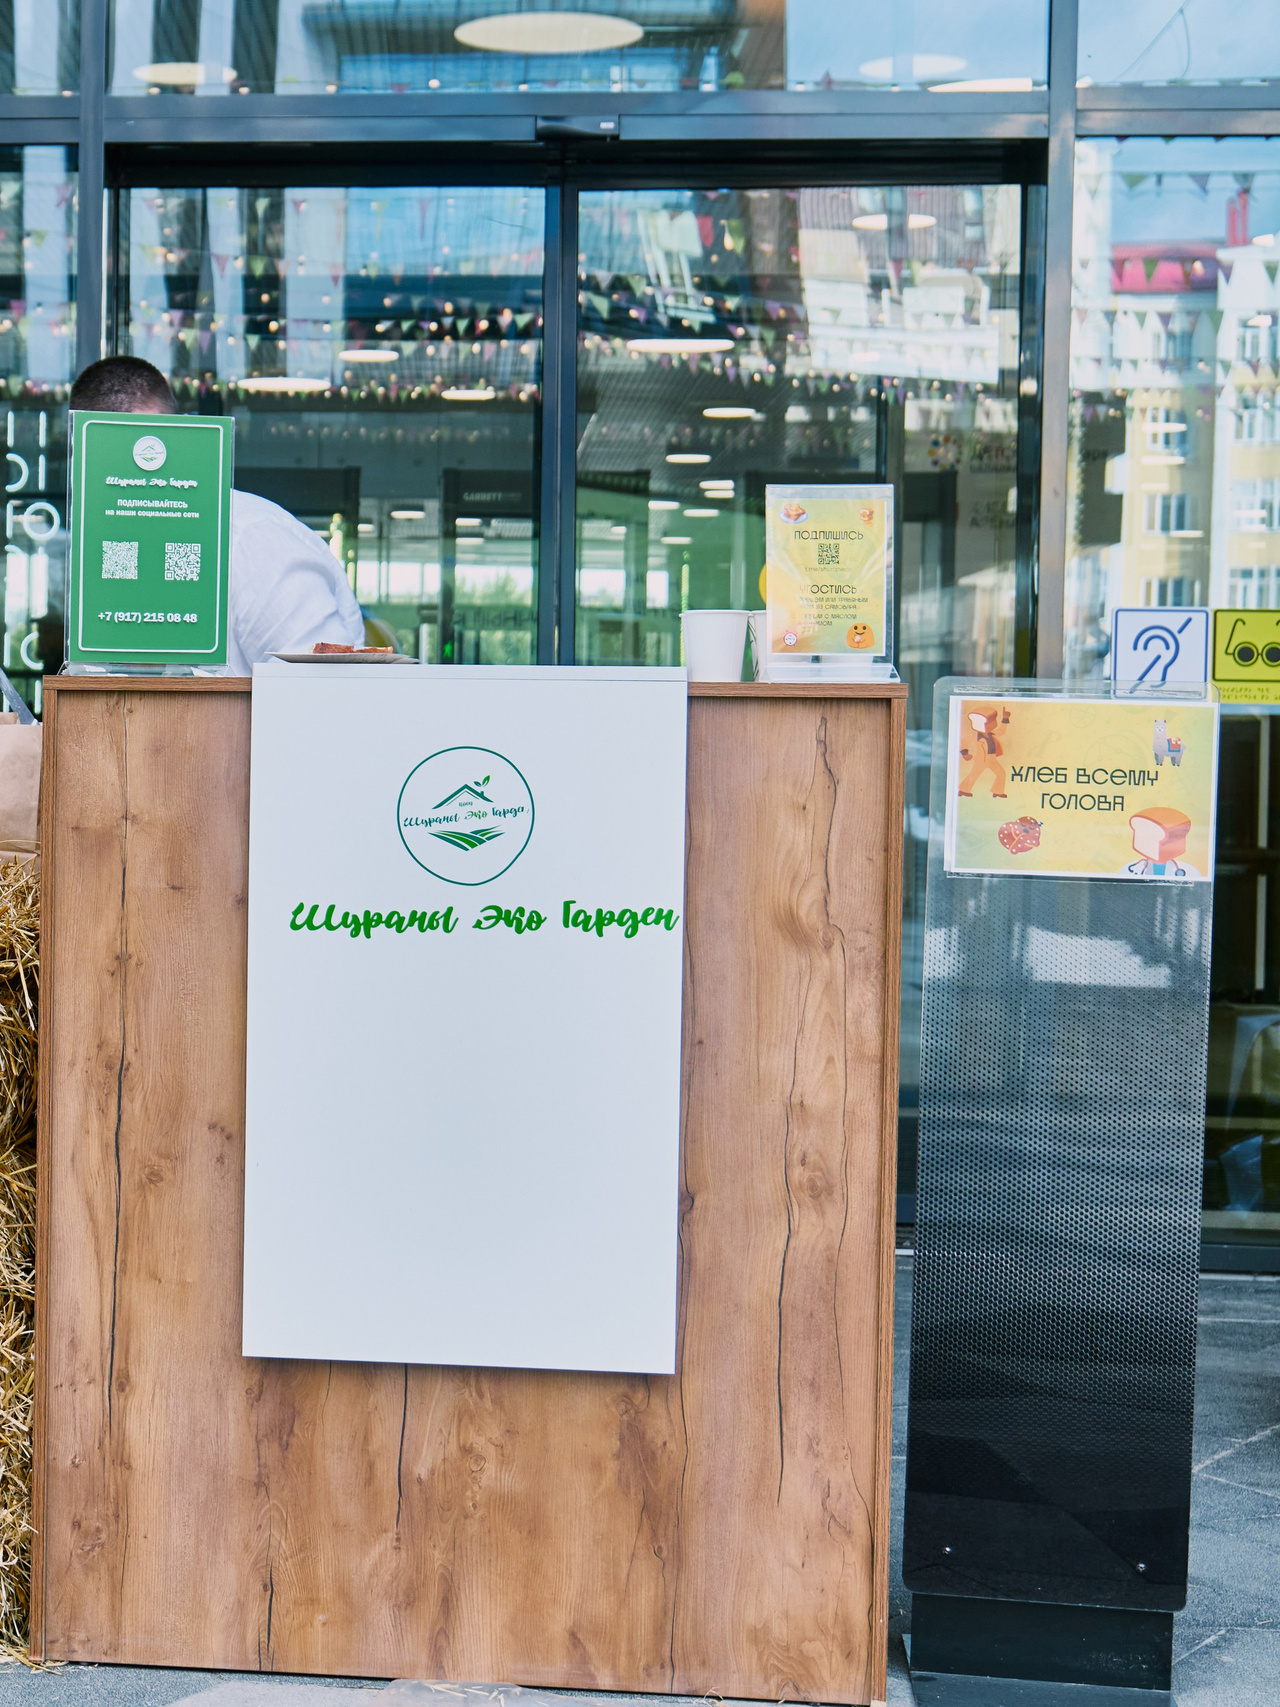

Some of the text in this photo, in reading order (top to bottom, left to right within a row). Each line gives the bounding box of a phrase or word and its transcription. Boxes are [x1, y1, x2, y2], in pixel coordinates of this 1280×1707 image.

[149, 478, 167, 487] Эко
[117, 499, 188, 508] ПОДПИСЫВАЙТЕСЬ
[794, 530, 864, 541] ПОДПИШИСЬ
[97, 611, 198, 623] +7 (917) 215 08 48
[1011, 765, 1159, 787] ХЛЕБ ВСЕМУ
[1041, 792, 1125, 812] ГОЛОВА
[403, 812, 460, 827] Шураны
[464, 810, 488, 820] Эко
[289, 900, 680, 939] Шураны Эко Гарден
